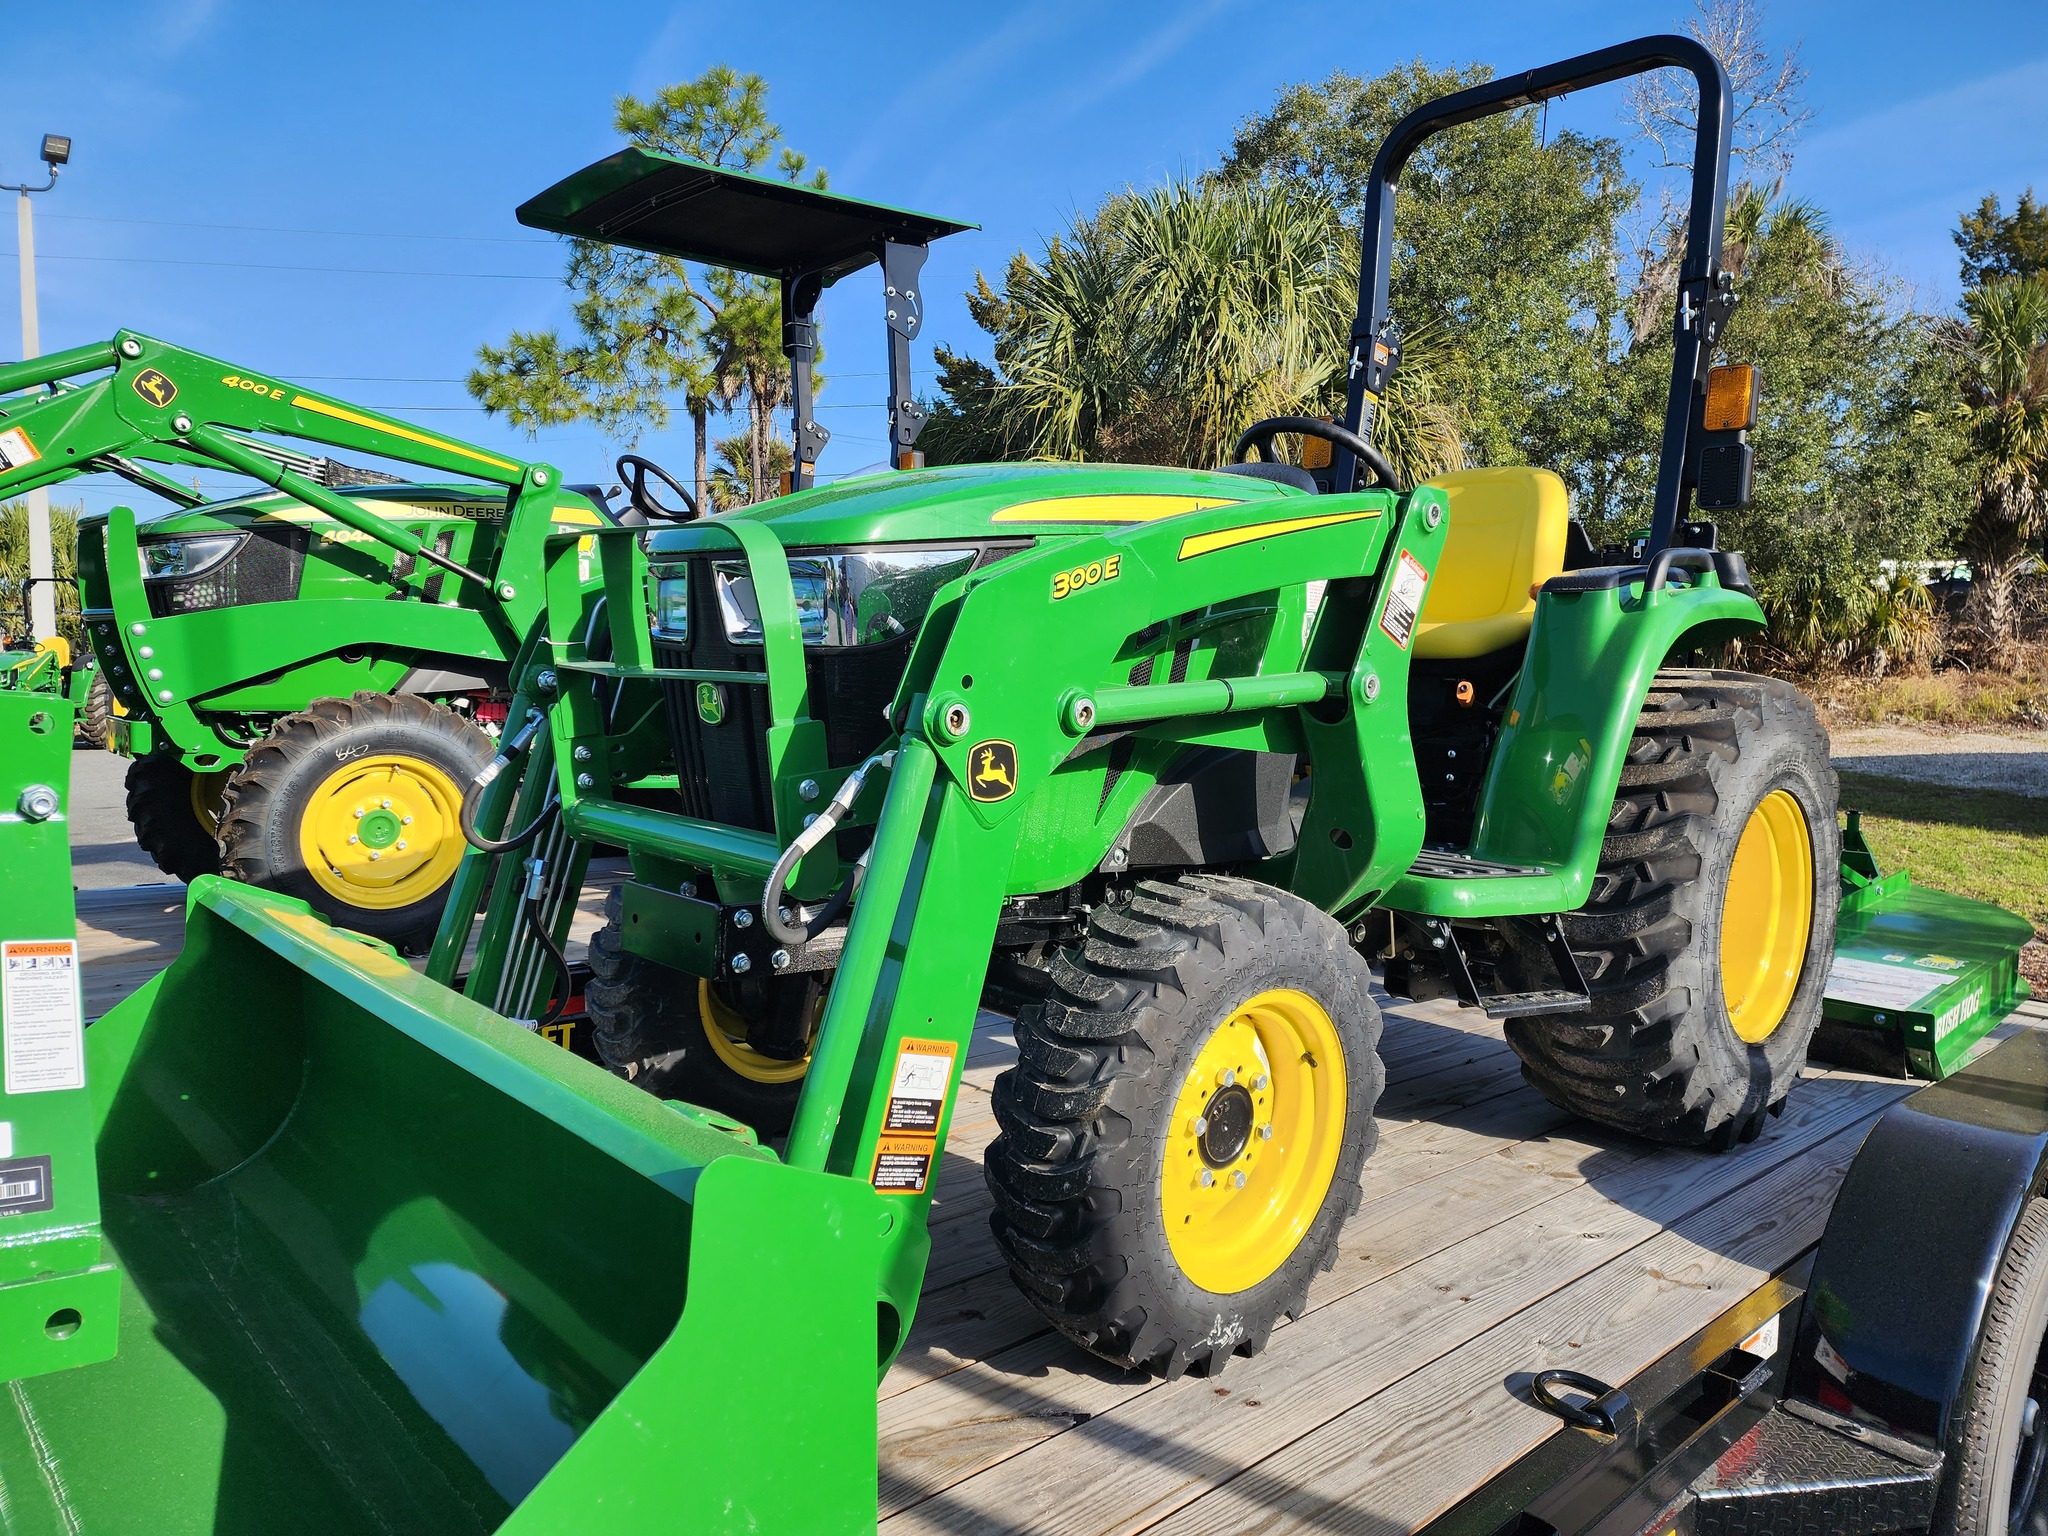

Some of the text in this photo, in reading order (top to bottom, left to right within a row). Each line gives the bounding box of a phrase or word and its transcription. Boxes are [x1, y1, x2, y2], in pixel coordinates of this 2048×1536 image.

[409, 503, 505, 518] JOHN DEERE
[18, 946, 70, 954] WARNING
[1935, 1003, 1961, 1043] BUSH
[916, 1043, 950, 1054] WARNING
[893, 1143, 928, 1152] WARNING
